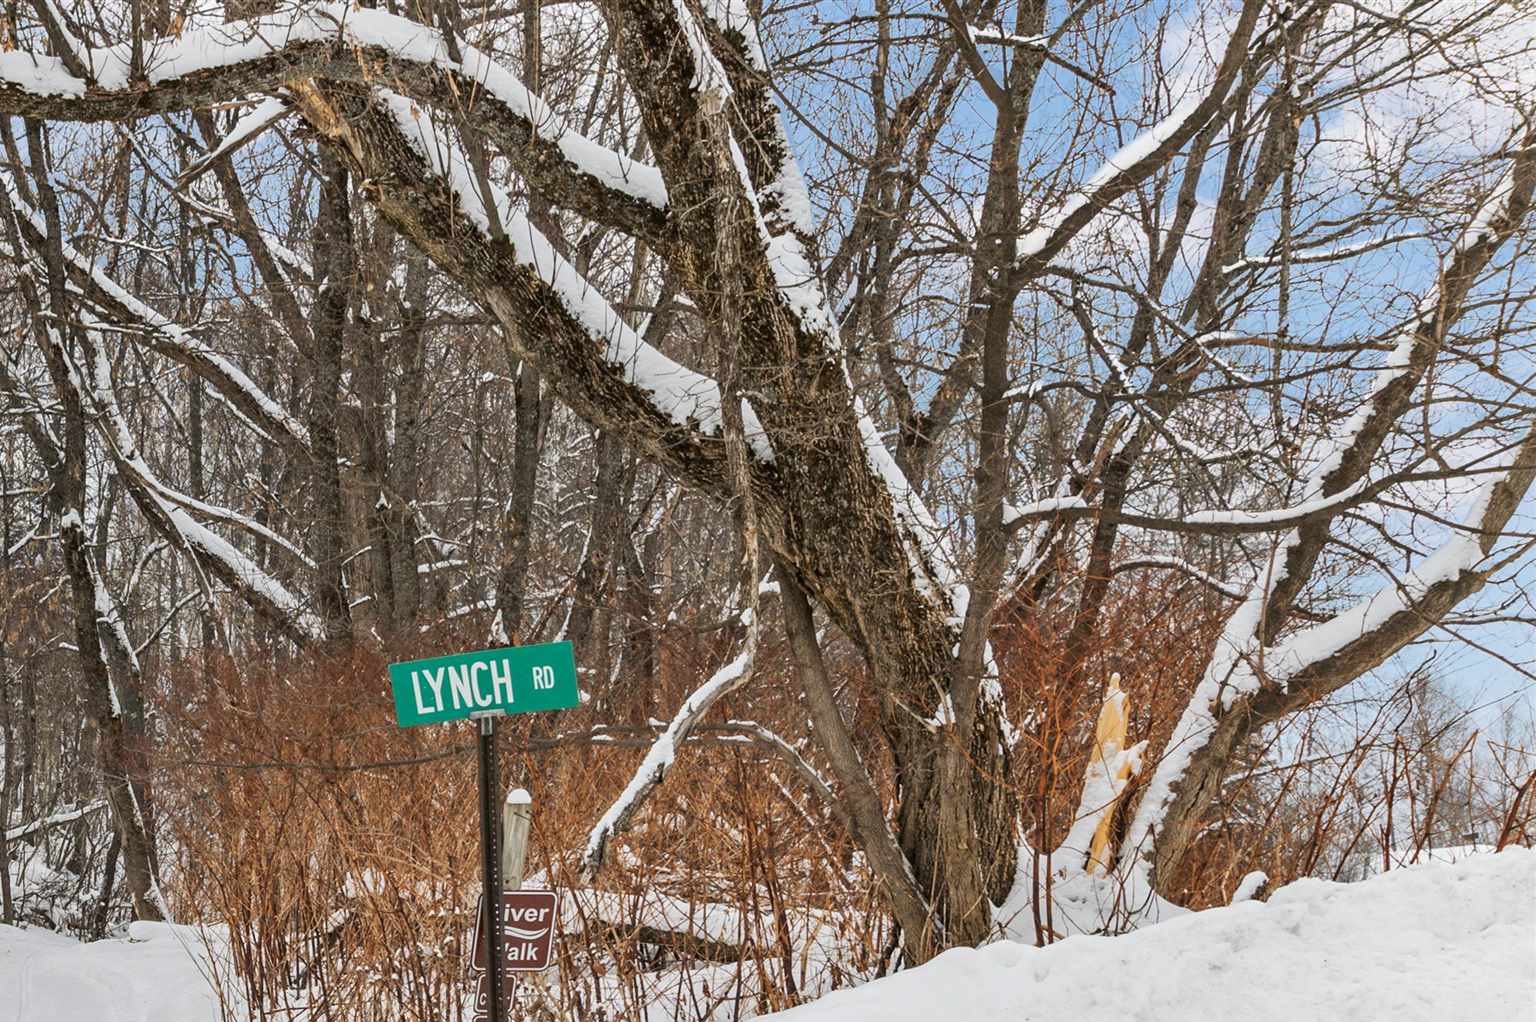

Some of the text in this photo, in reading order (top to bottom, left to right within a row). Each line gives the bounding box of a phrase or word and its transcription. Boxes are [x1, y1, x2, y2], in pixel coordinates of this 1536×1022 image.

[411, 659, 555, 715] LYNCH RD
[503, 903, 549, 922] iver
[503, 942, 539, 961] alk
